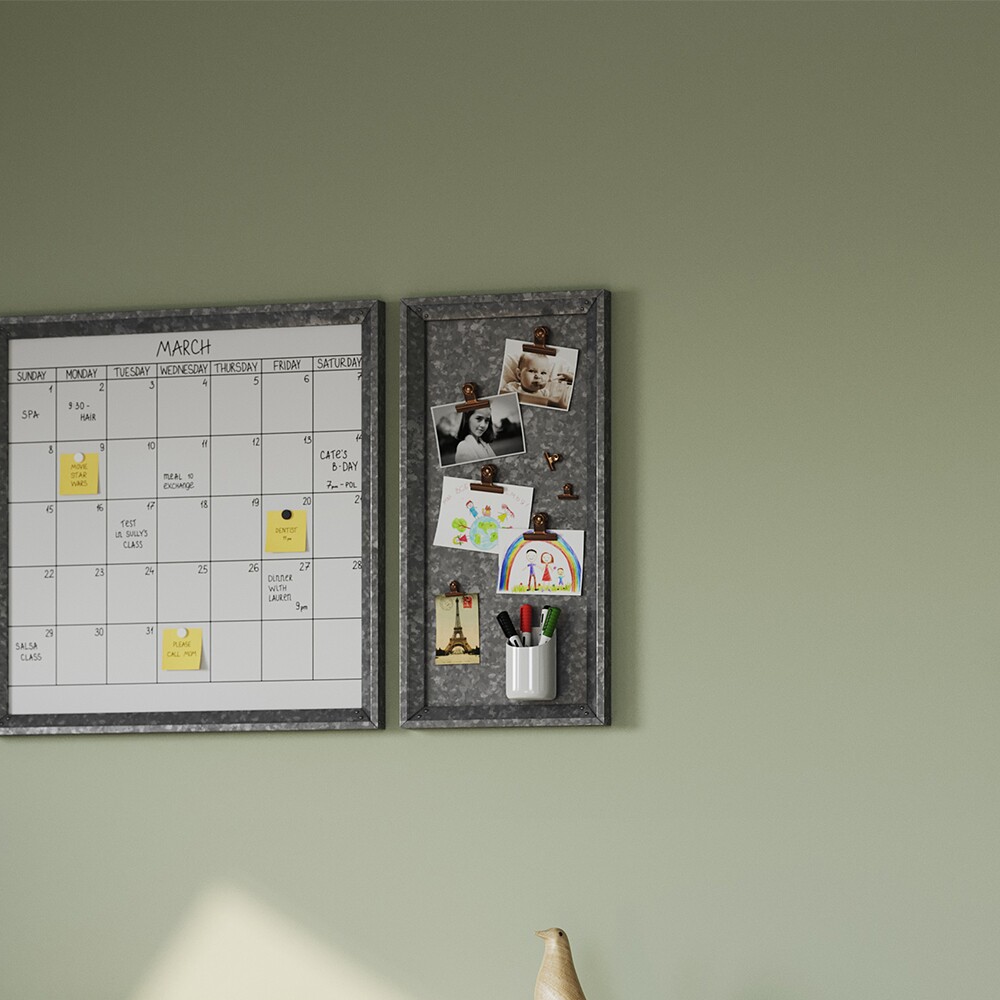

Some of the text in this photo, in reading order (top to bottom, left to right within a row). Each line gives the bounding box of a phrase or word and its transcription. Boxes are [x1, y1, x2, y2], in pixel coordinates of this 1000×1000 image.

[156, 338, 212, 357] MARCH
[16, 357, 362, 382] SUNDAY MONDAY TUESDAY WEDNESDAY THURSDAY FRIDAY SATURDAY
[98, 382, 104, 392] 2
[149, 380, 155, 390] 3
[202, 378, 208, 388] 4
[252, 376, 260, 386] 5
[304, 374, 310, 384] 6
[22, 410, 40, 420] SPA
[48, 445, 54, 454] 8
[100, 442, 105, 452] 9
[147, 442, 156, 450] 10
[202, 439, 208, 448] 11
[252, 438, 260, 446] 12
[303, 436, 312, 444] 13
[46, 496, 312, 514] 15 16 17 18 19 20
[122, 540, 144, 549] CLASS
[44, 560, 362, 578] 22 23 24 25 26 27 28
[44, 626, 154, 638] 29 30 31
[15, 642, 38, 650] SALSA
[172, 640, 192, 648] PLEASE
[20, 653, 42, 662] CLASS
